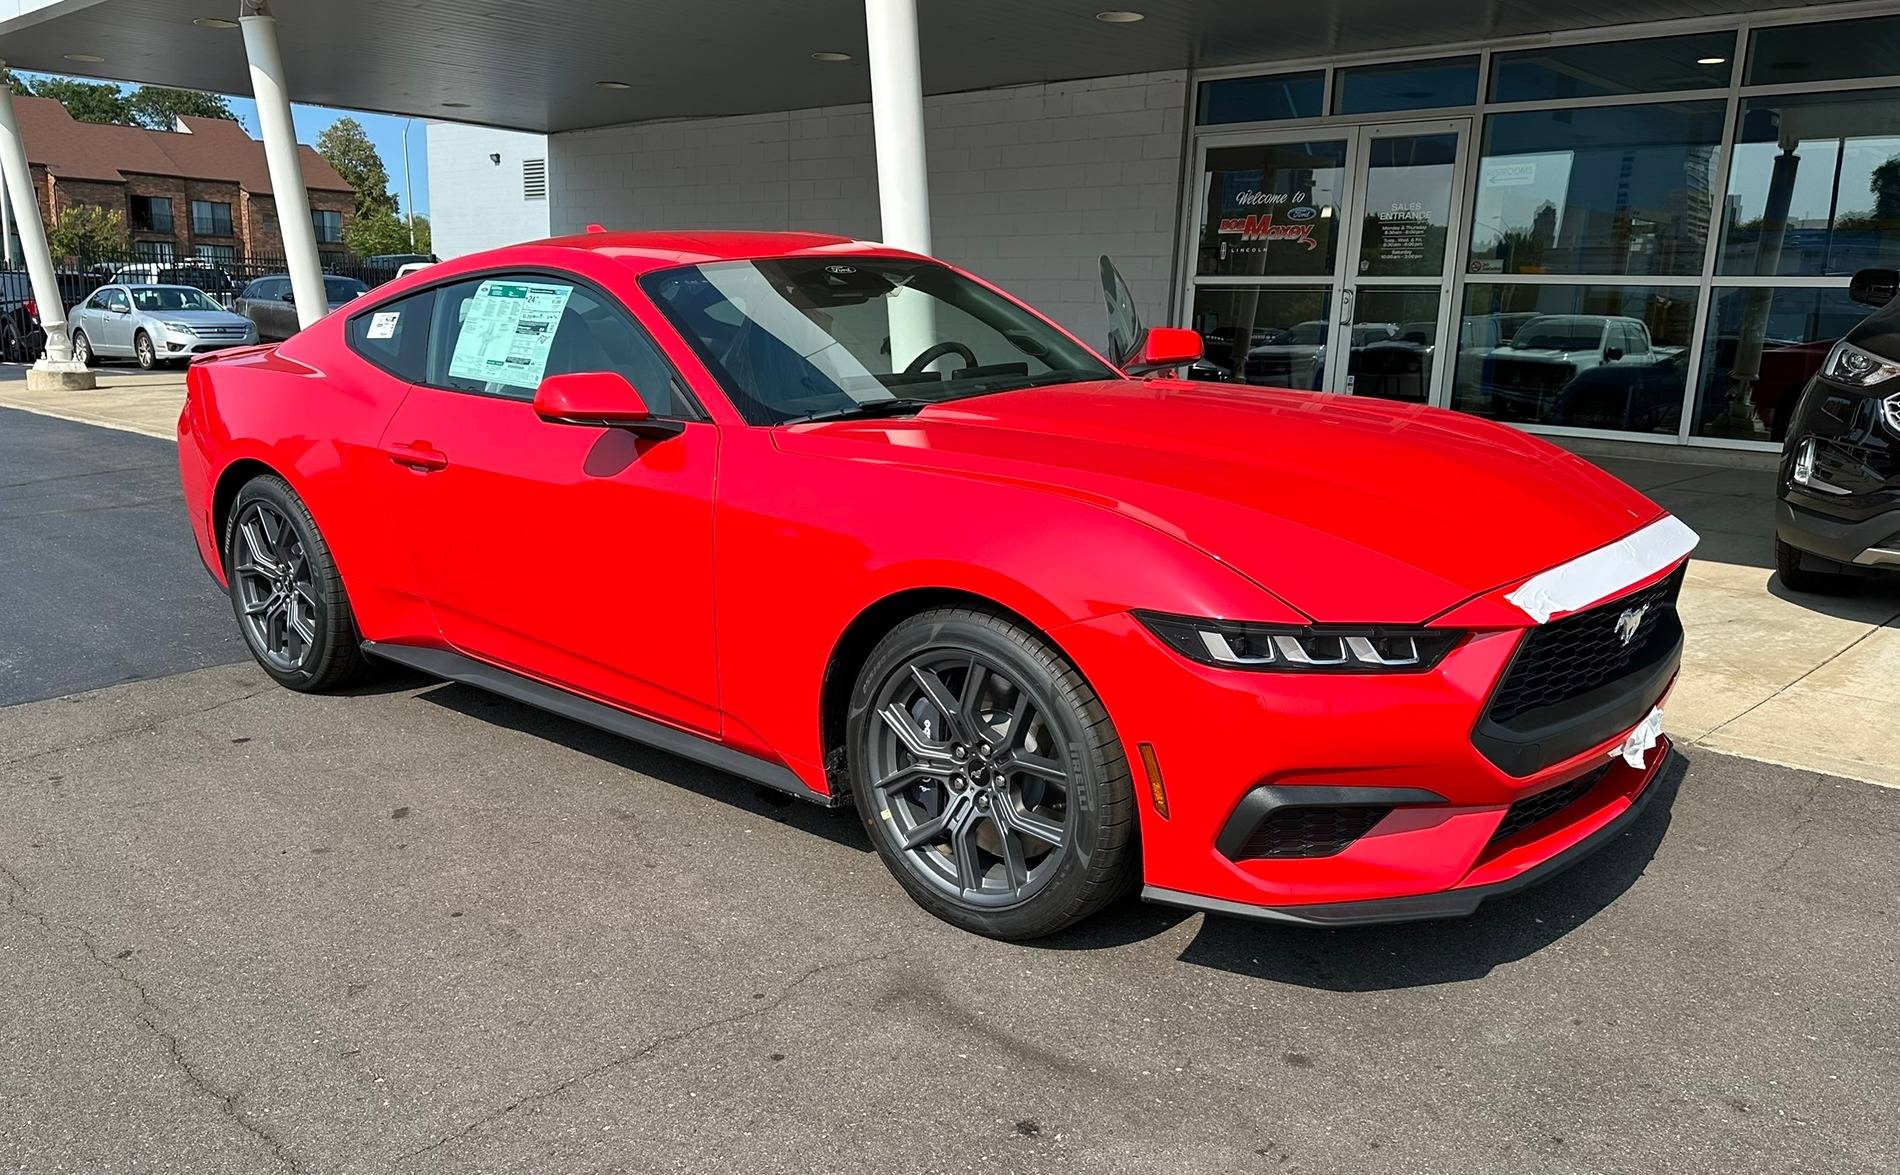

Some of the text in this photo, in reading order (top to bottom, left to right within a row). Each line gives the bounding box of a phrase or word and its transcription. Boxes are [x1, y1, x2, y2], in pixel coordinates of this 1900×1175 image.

[1236, 190, 1305, 205] Welcome to
[1391, 202, 1422, 211] SALES
[1293, 209, 1310, 218] Ford
[1380, 210, 1432, 220] ENTRANCE
[1220, 214, 1317, 250] BOB Maxey
[1069, 742, 1092, 812] PIRELLI
